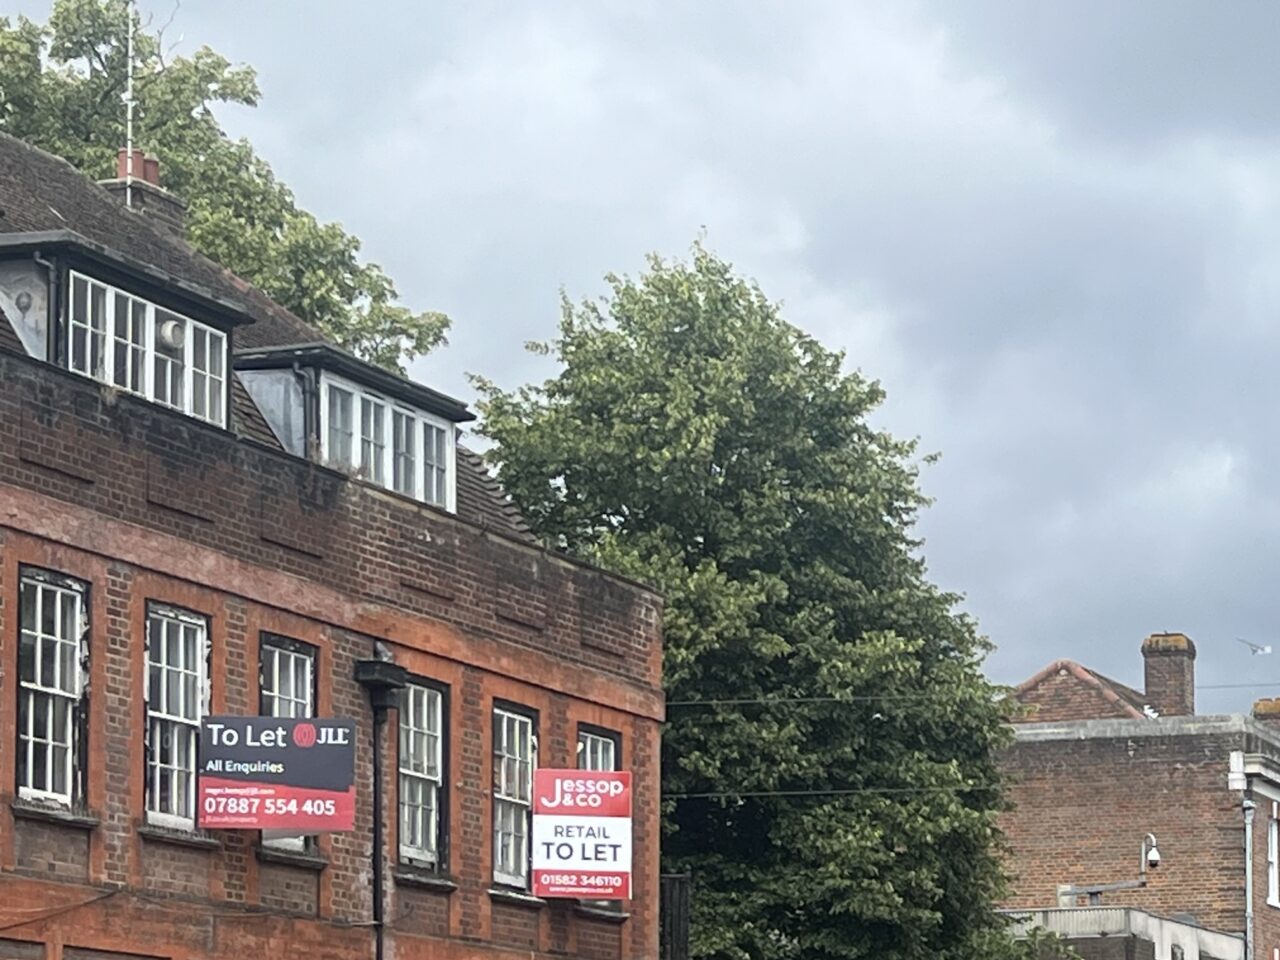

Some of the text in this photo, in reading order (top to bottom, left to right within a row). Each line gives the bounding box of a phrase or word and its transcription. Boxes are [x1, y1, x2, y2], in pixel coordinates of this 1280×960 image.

[207, 724, 287, 747] To Let
[317, 727, 349, 745] JLL
[206, 760, 285, 774] All Enquiries
[541, 778, 625, 808] Jessop
[204, 797, 336, 816] 07887 554 405
[554, 825, 610, 839] RETAIL
[541, 842, 622, 862] TO LET
[541, 874, 577, 886] 01582
